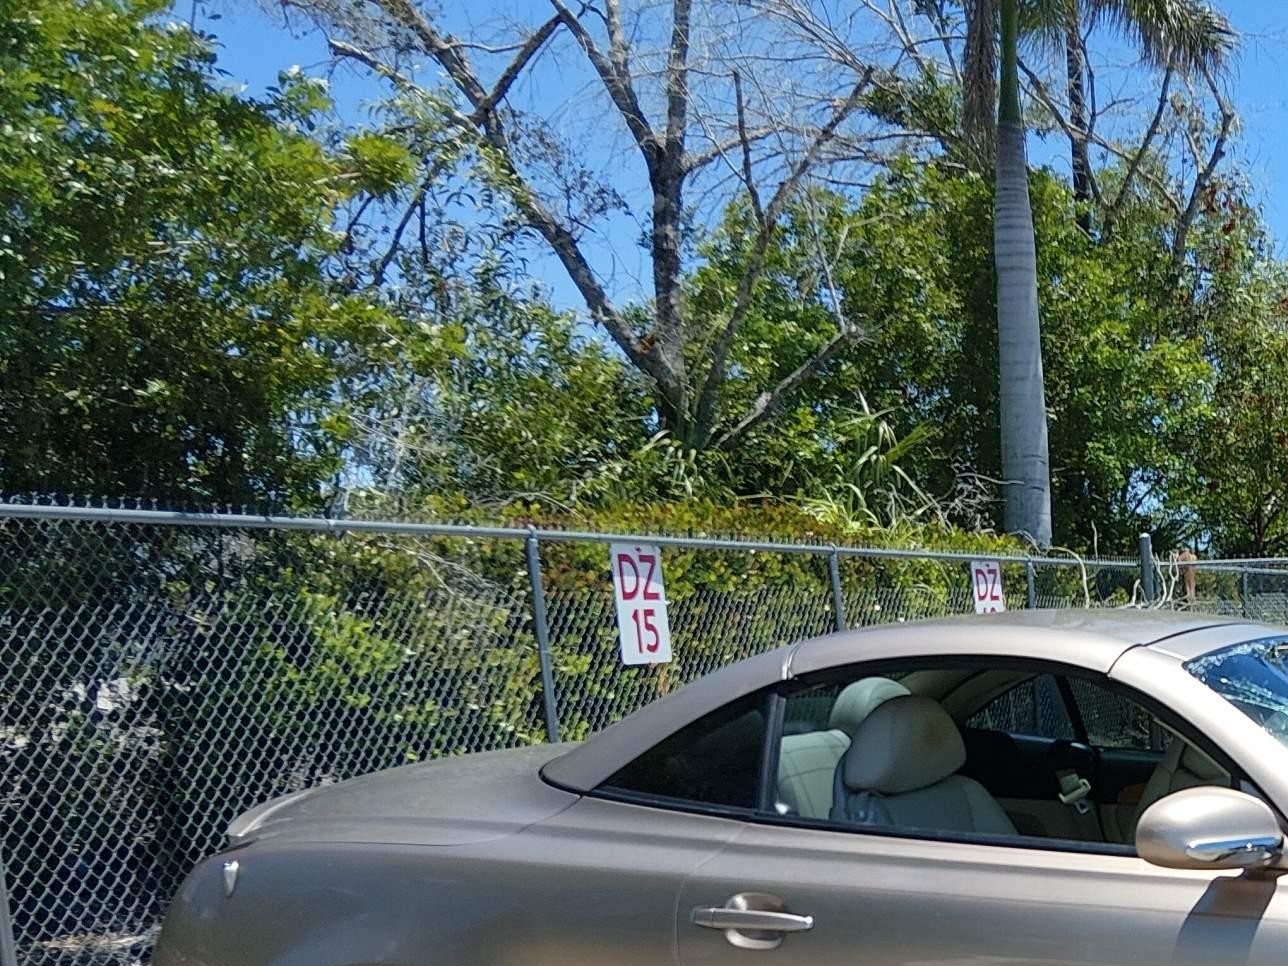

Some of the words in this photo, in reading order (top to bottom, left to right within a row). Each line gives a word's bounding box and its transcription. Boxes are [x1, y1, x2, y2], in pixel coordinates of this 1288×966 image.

[617, 553, 660, 600] DZ
[975, 569, 1000, 601] DZ
[632, 609, 659, 654] 15
